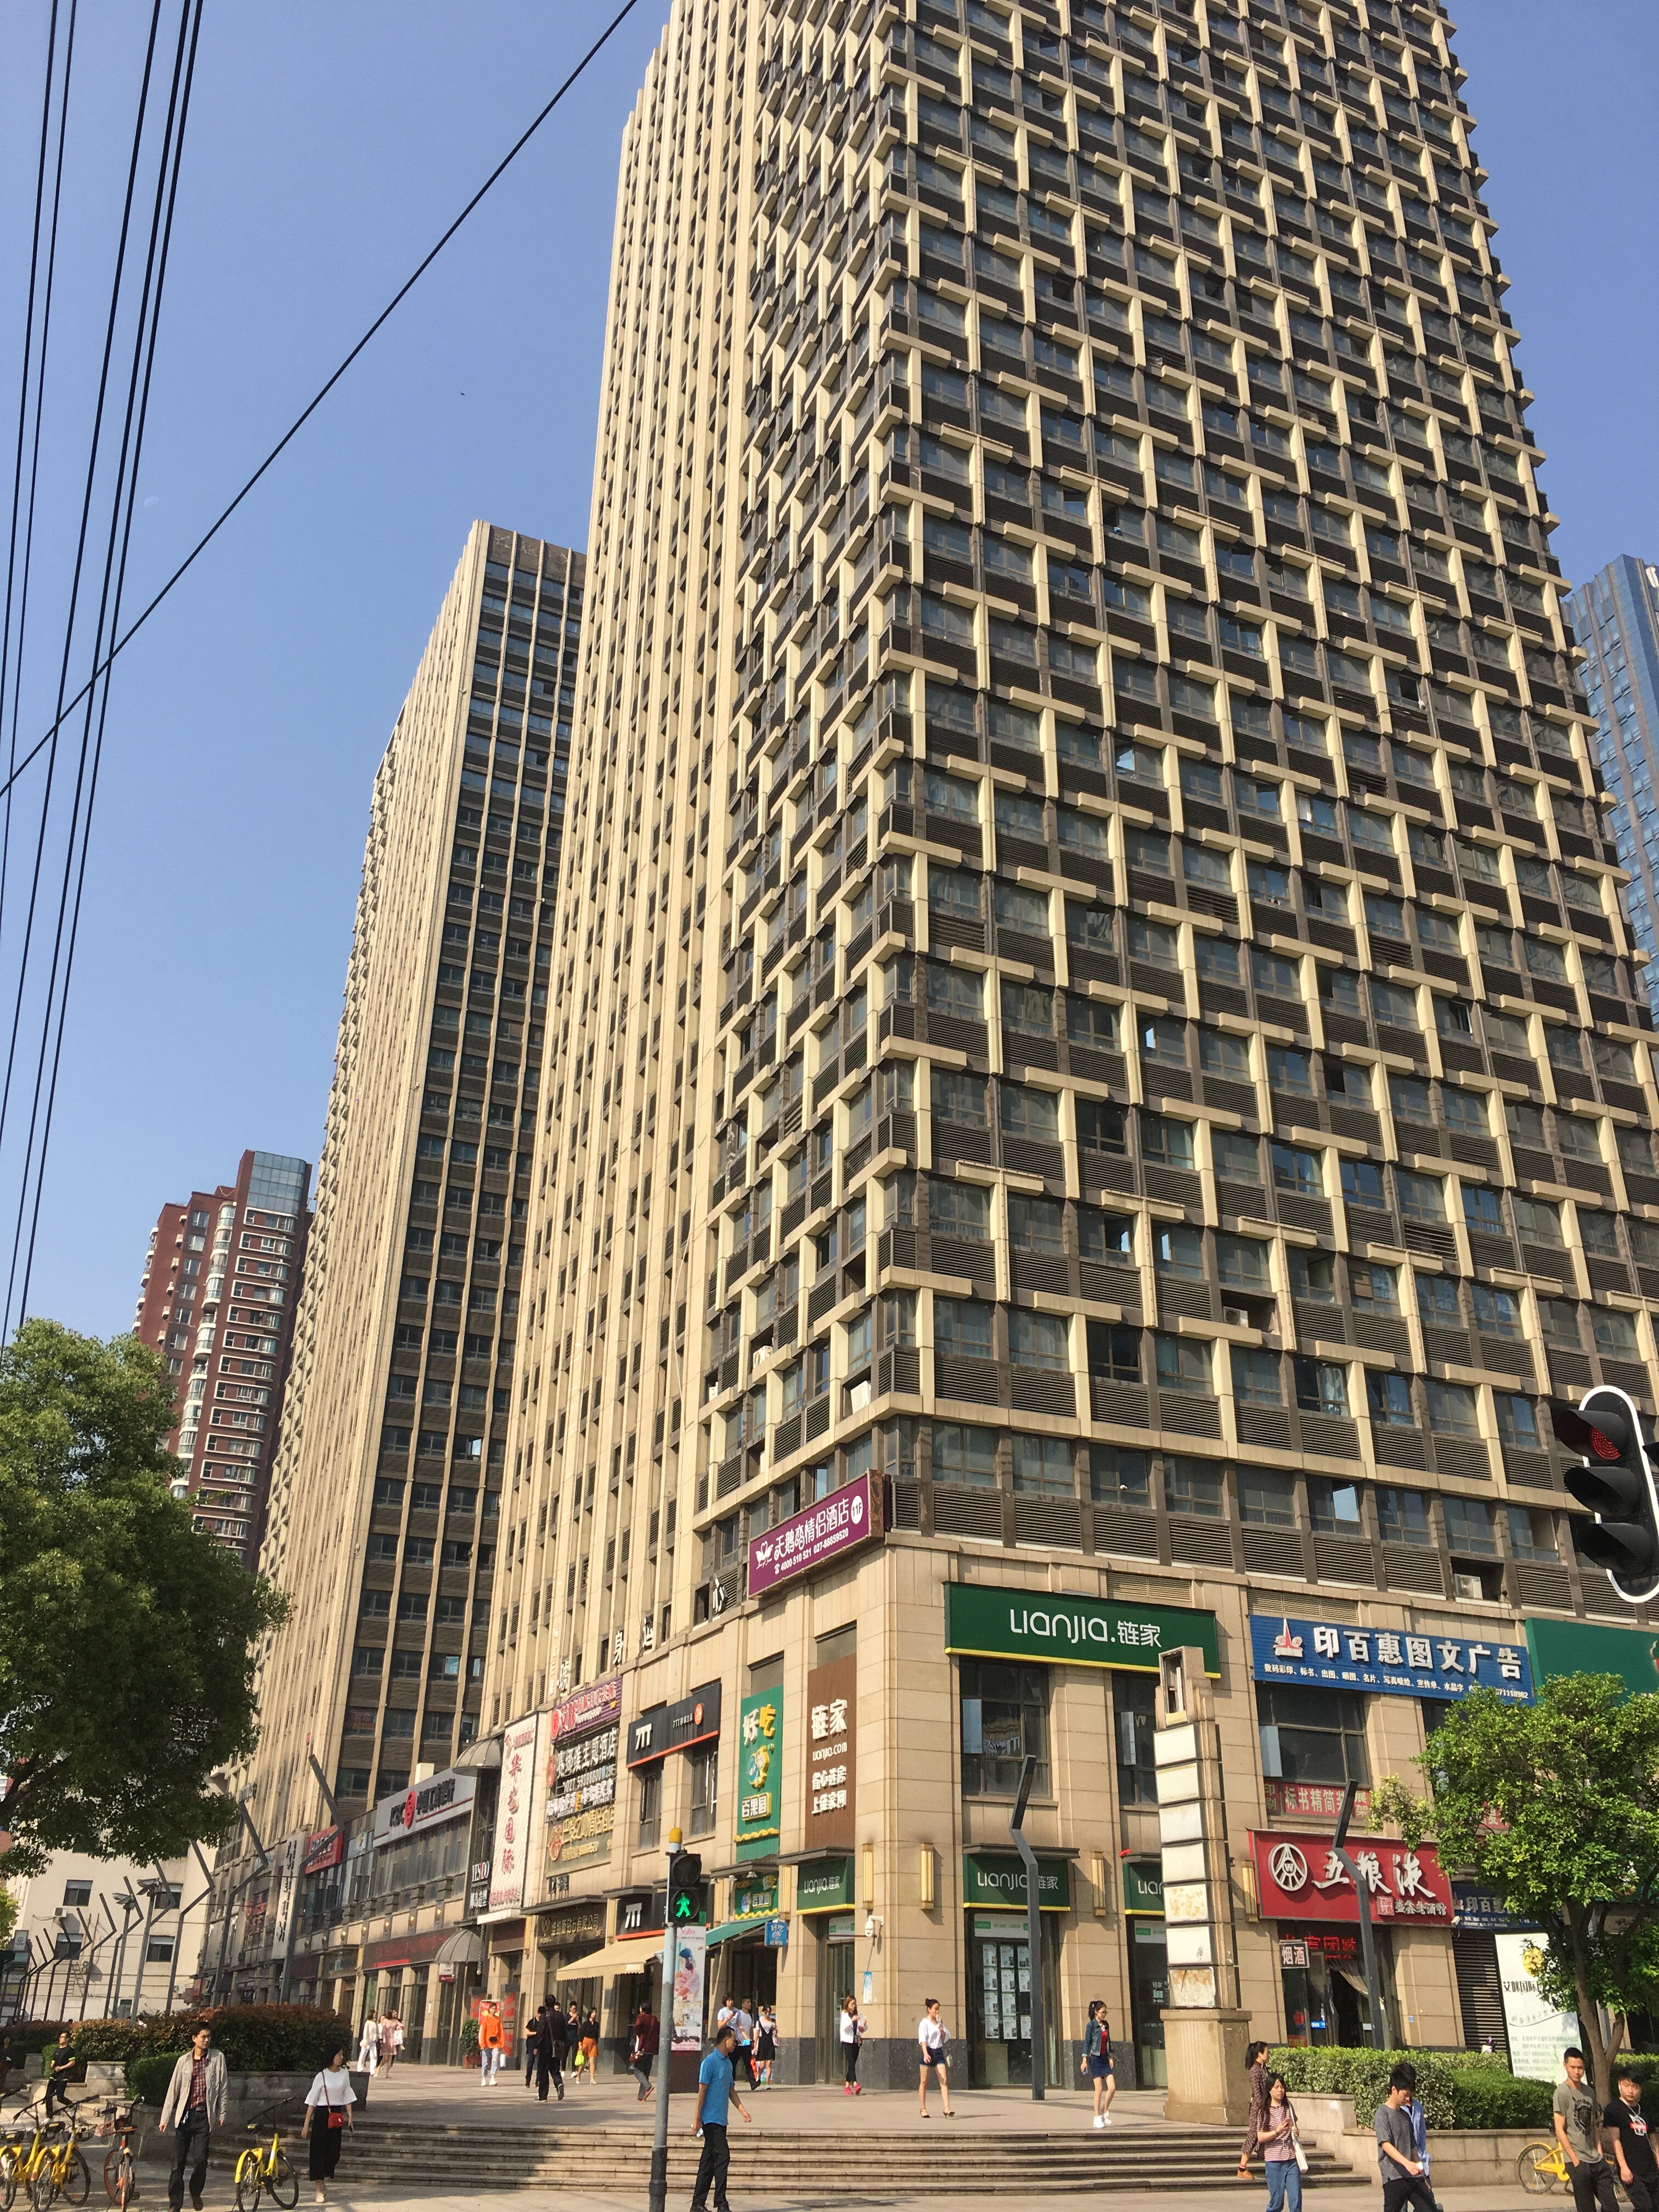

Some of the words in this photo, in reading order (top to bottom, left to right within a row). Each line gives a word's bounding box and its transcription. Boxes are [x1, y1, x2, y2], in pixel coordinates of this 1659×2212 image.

[851, 1502, 862, 1517] 11F
[803, 1550, 811, 1560] 521
[1314, 1626, 1521, 1679] 印百惠图文广告
[743, 1704, 777, 1746] 好吃
[811, 1699, 848, 1740] 链家
[811, 1765, 847, 1791] 省心选房
[742, 1795, 767, 1820] 百果园
[811, 1790, 847, 1814] 上链家网
[1355, 1791, 1369, 1817] 展架
[1312, 1850, 1436, 1898] 五粮液
[1465, 1896, 1506, 1914] 印百惠
[1282, 1946, 1306, 1965] 烟酒
[1503, 1980, 1539, 1993] 艾咪国际
